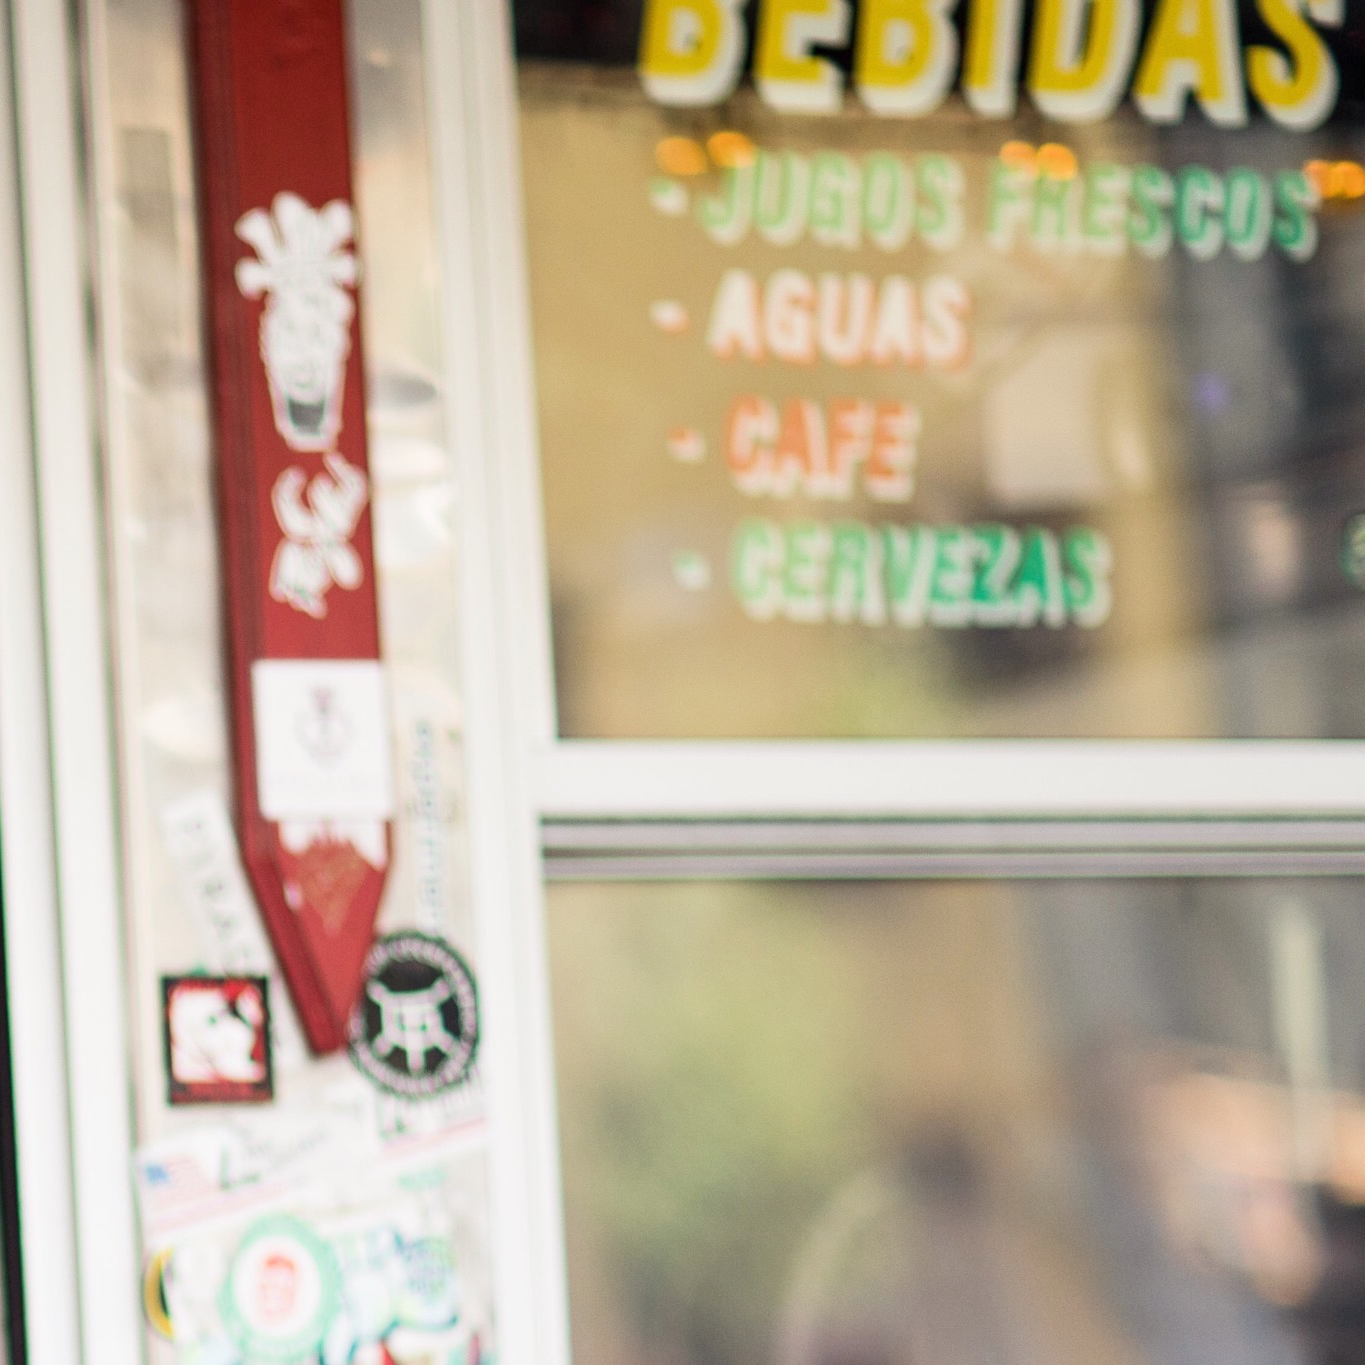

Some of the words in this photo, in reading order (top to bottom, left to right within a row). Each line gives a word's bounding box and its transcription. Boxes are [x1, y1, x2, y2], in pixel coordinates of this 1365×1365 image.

[697, 150, 965, 251] JUGOS
[987, 160, 1321, 261] FRESCOS
[706, 269, 970, 370] AGUAS
[725, 394, 920, 502] CAFE
[734, 515, 1111, 628] CERVEZAS
